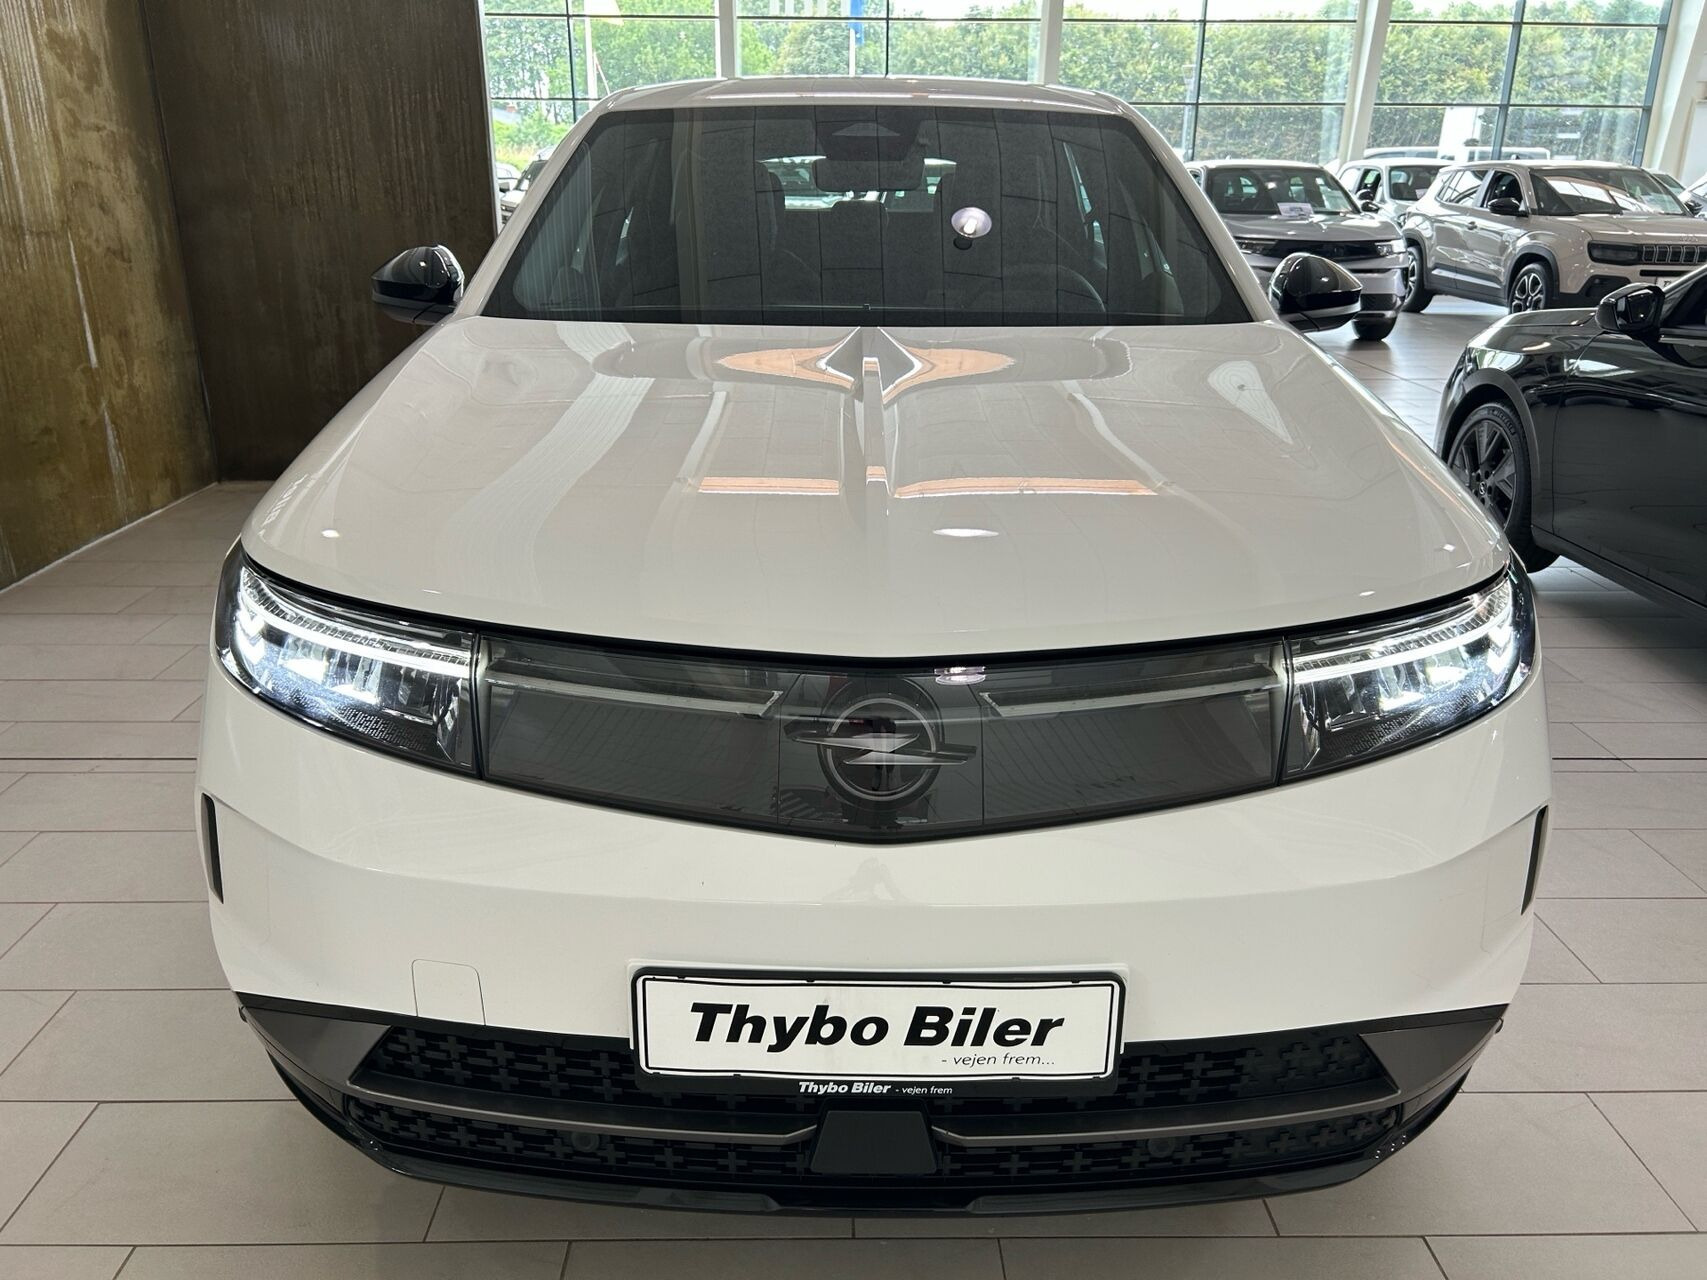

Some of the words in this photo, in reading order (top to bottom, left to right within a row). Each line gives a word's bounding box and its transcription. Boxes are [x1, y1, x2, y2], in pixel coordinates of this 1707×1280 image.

[690, 1001, 889, 1053] Thybo
[903, 1005, 1065, 1048] Biler
[953, 1053, 997, 1069] vejen
[1001, 1051, 1055, 1066] frem...
[798, 1081, 849, 1095] Thybo
[850, 1081, 892, 1094] Biler
[901, 1085, 928, 1095] vejen
[930, 1085, 953, 1095] frem
